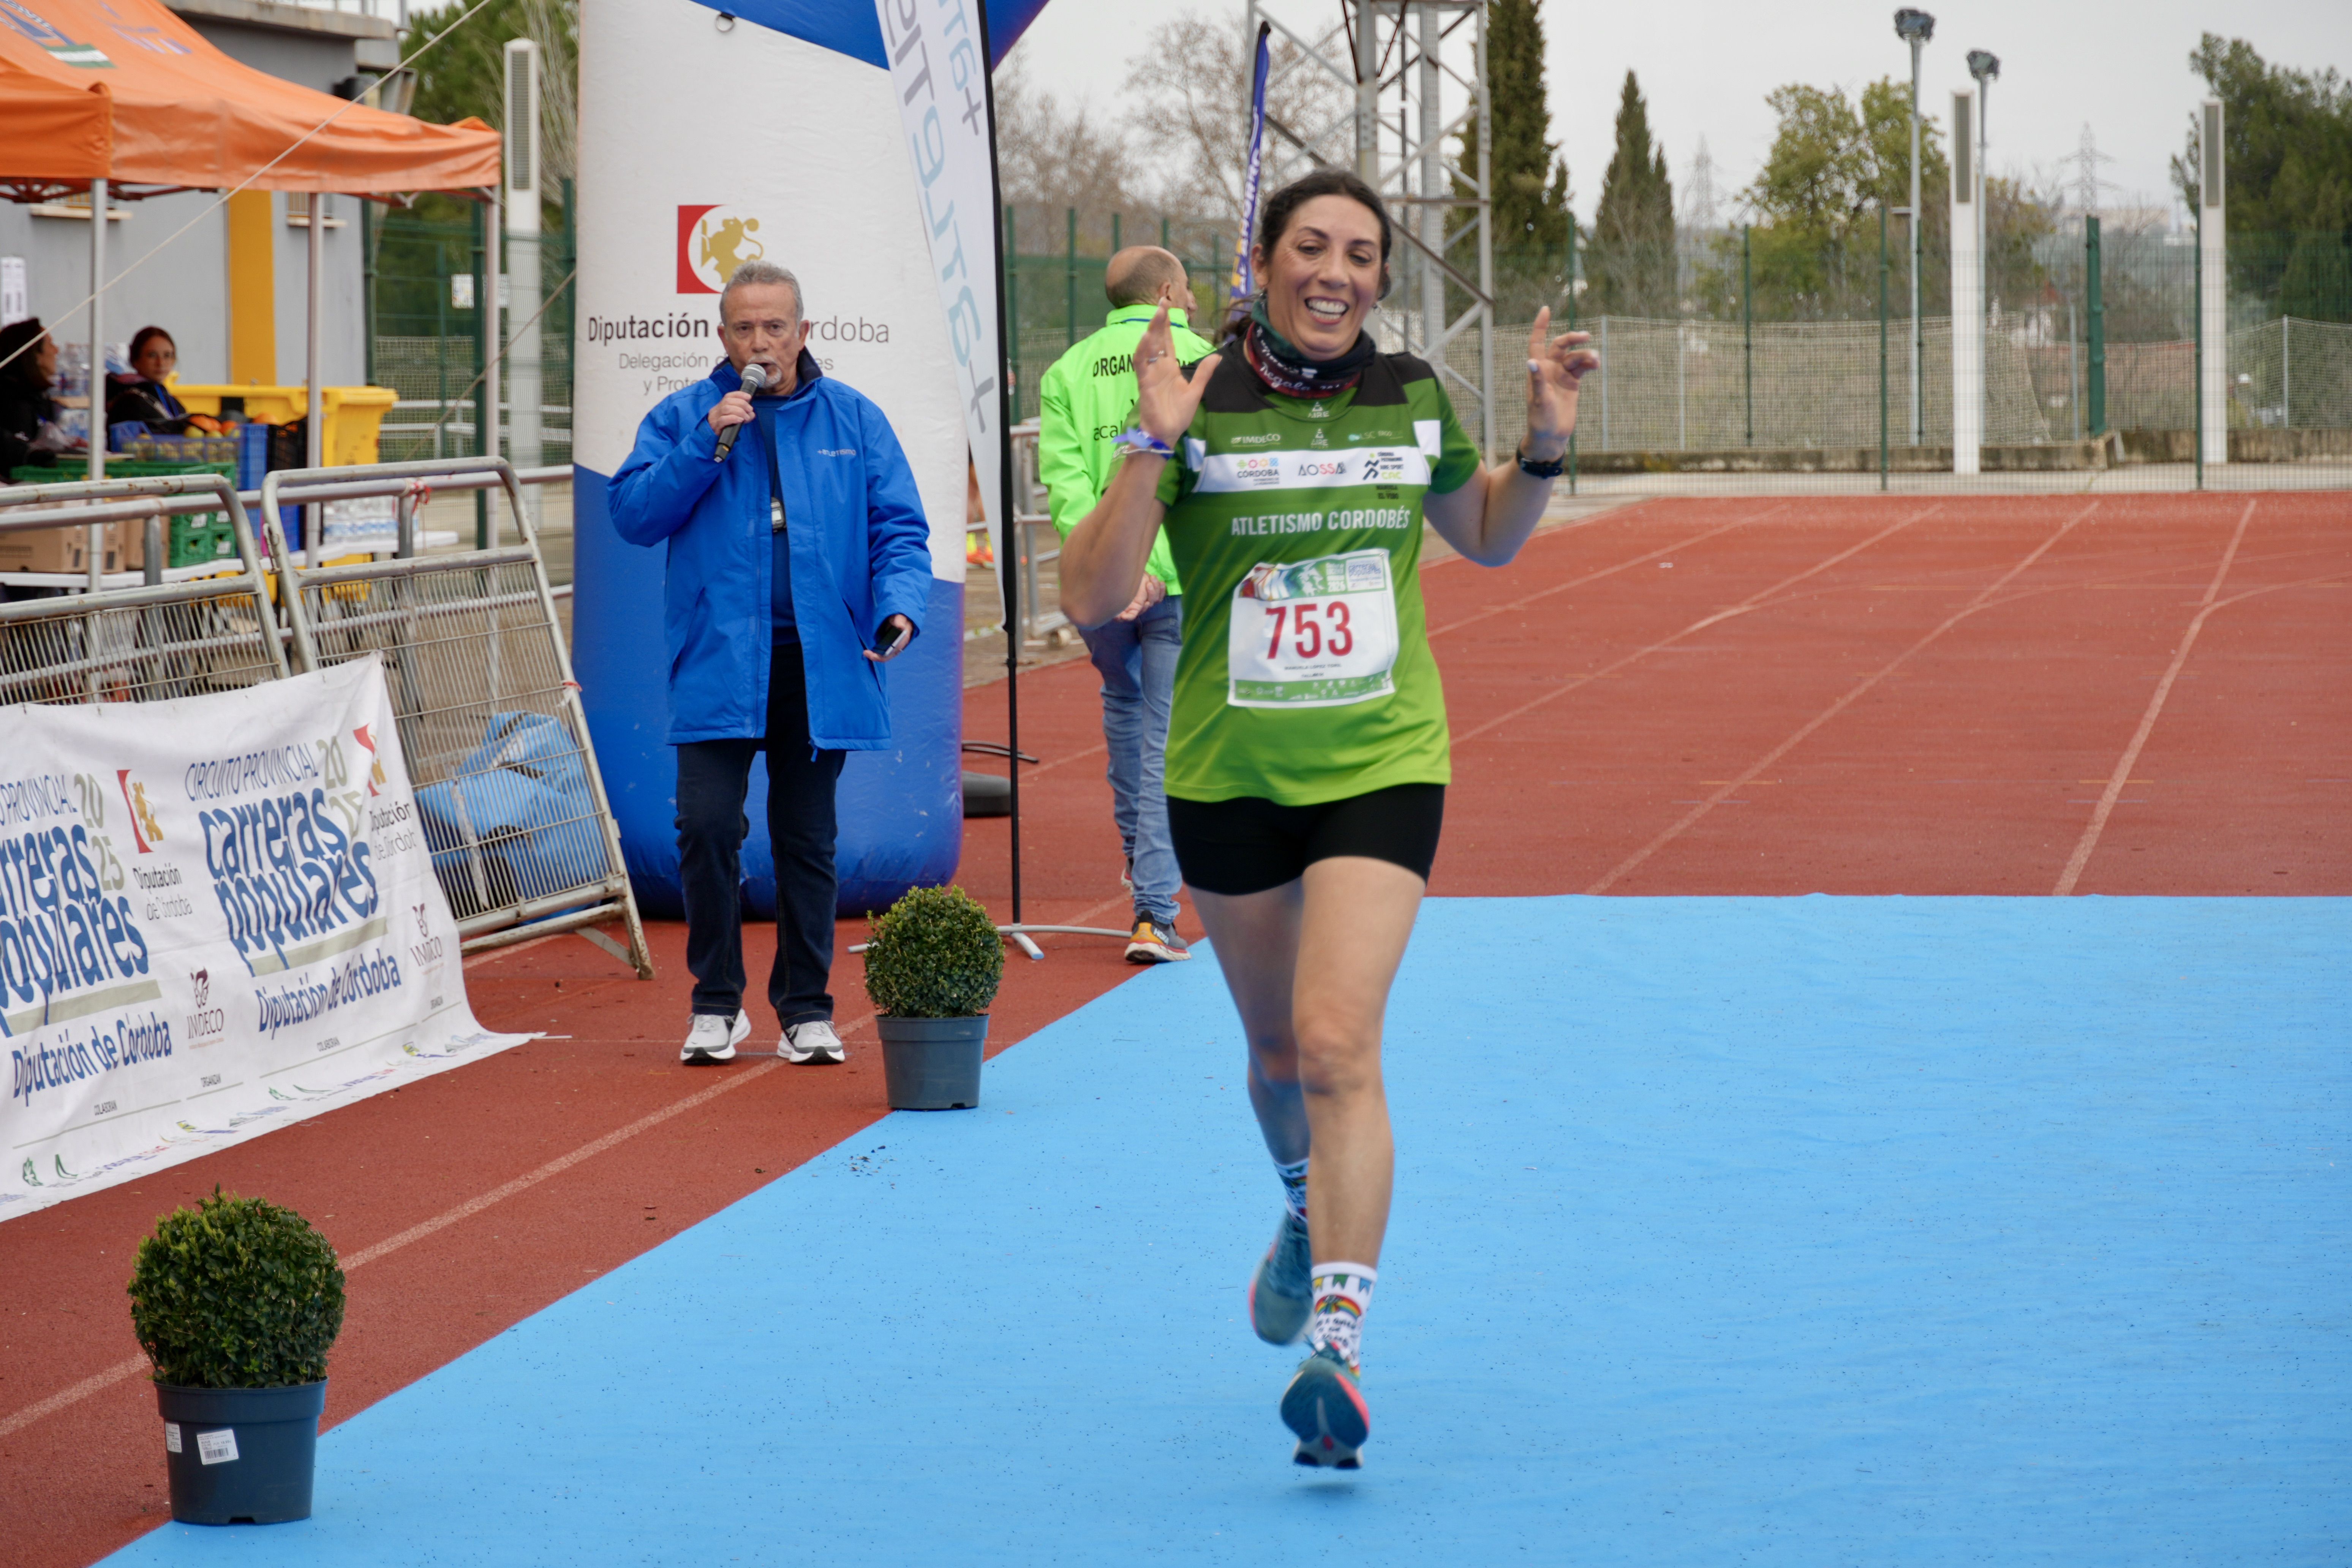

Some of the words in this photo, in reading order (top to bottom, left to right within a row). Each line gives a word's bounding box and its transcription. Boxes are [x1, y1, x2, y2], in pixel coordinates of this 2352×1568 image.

[588, 312, 709, 345] Diputación
[809, 315, 889, 343] rdoba
[619, 352, 708, 372] Delegación
[1237, 468, 1280, 478] CÓRDOBA
[1231, 512, 1322, 536] ATLETISMO
[1328, 505, 1410, 530] CORDOBÉS
[1265, 601, 1353, 659] 753
[185, 757, 241, 801] CIRCUITO
[243, 743, 319, 791] PROVINCIAL
[316, 735, 348, 790] 20
[3, 774, 78, 824] PROVINCIAL
[74, 773, 104, 828] 20
[91, 836, 125, 891] 25
[199, 788, 348, 885] carreras
[133, 862, 183, 895] Diputación
[158, 892, 193, 918] Córdoba
[214, 842, 378, 977] populares
[255, 978, 327, 1040] Diputación
[341, 948, 402, 1005] Córdoba
[12, 1029, 99, 1107] Diputación
[91, 1026, 119, 1071] de
[116, 1011, 172, 1066] Córdoba
